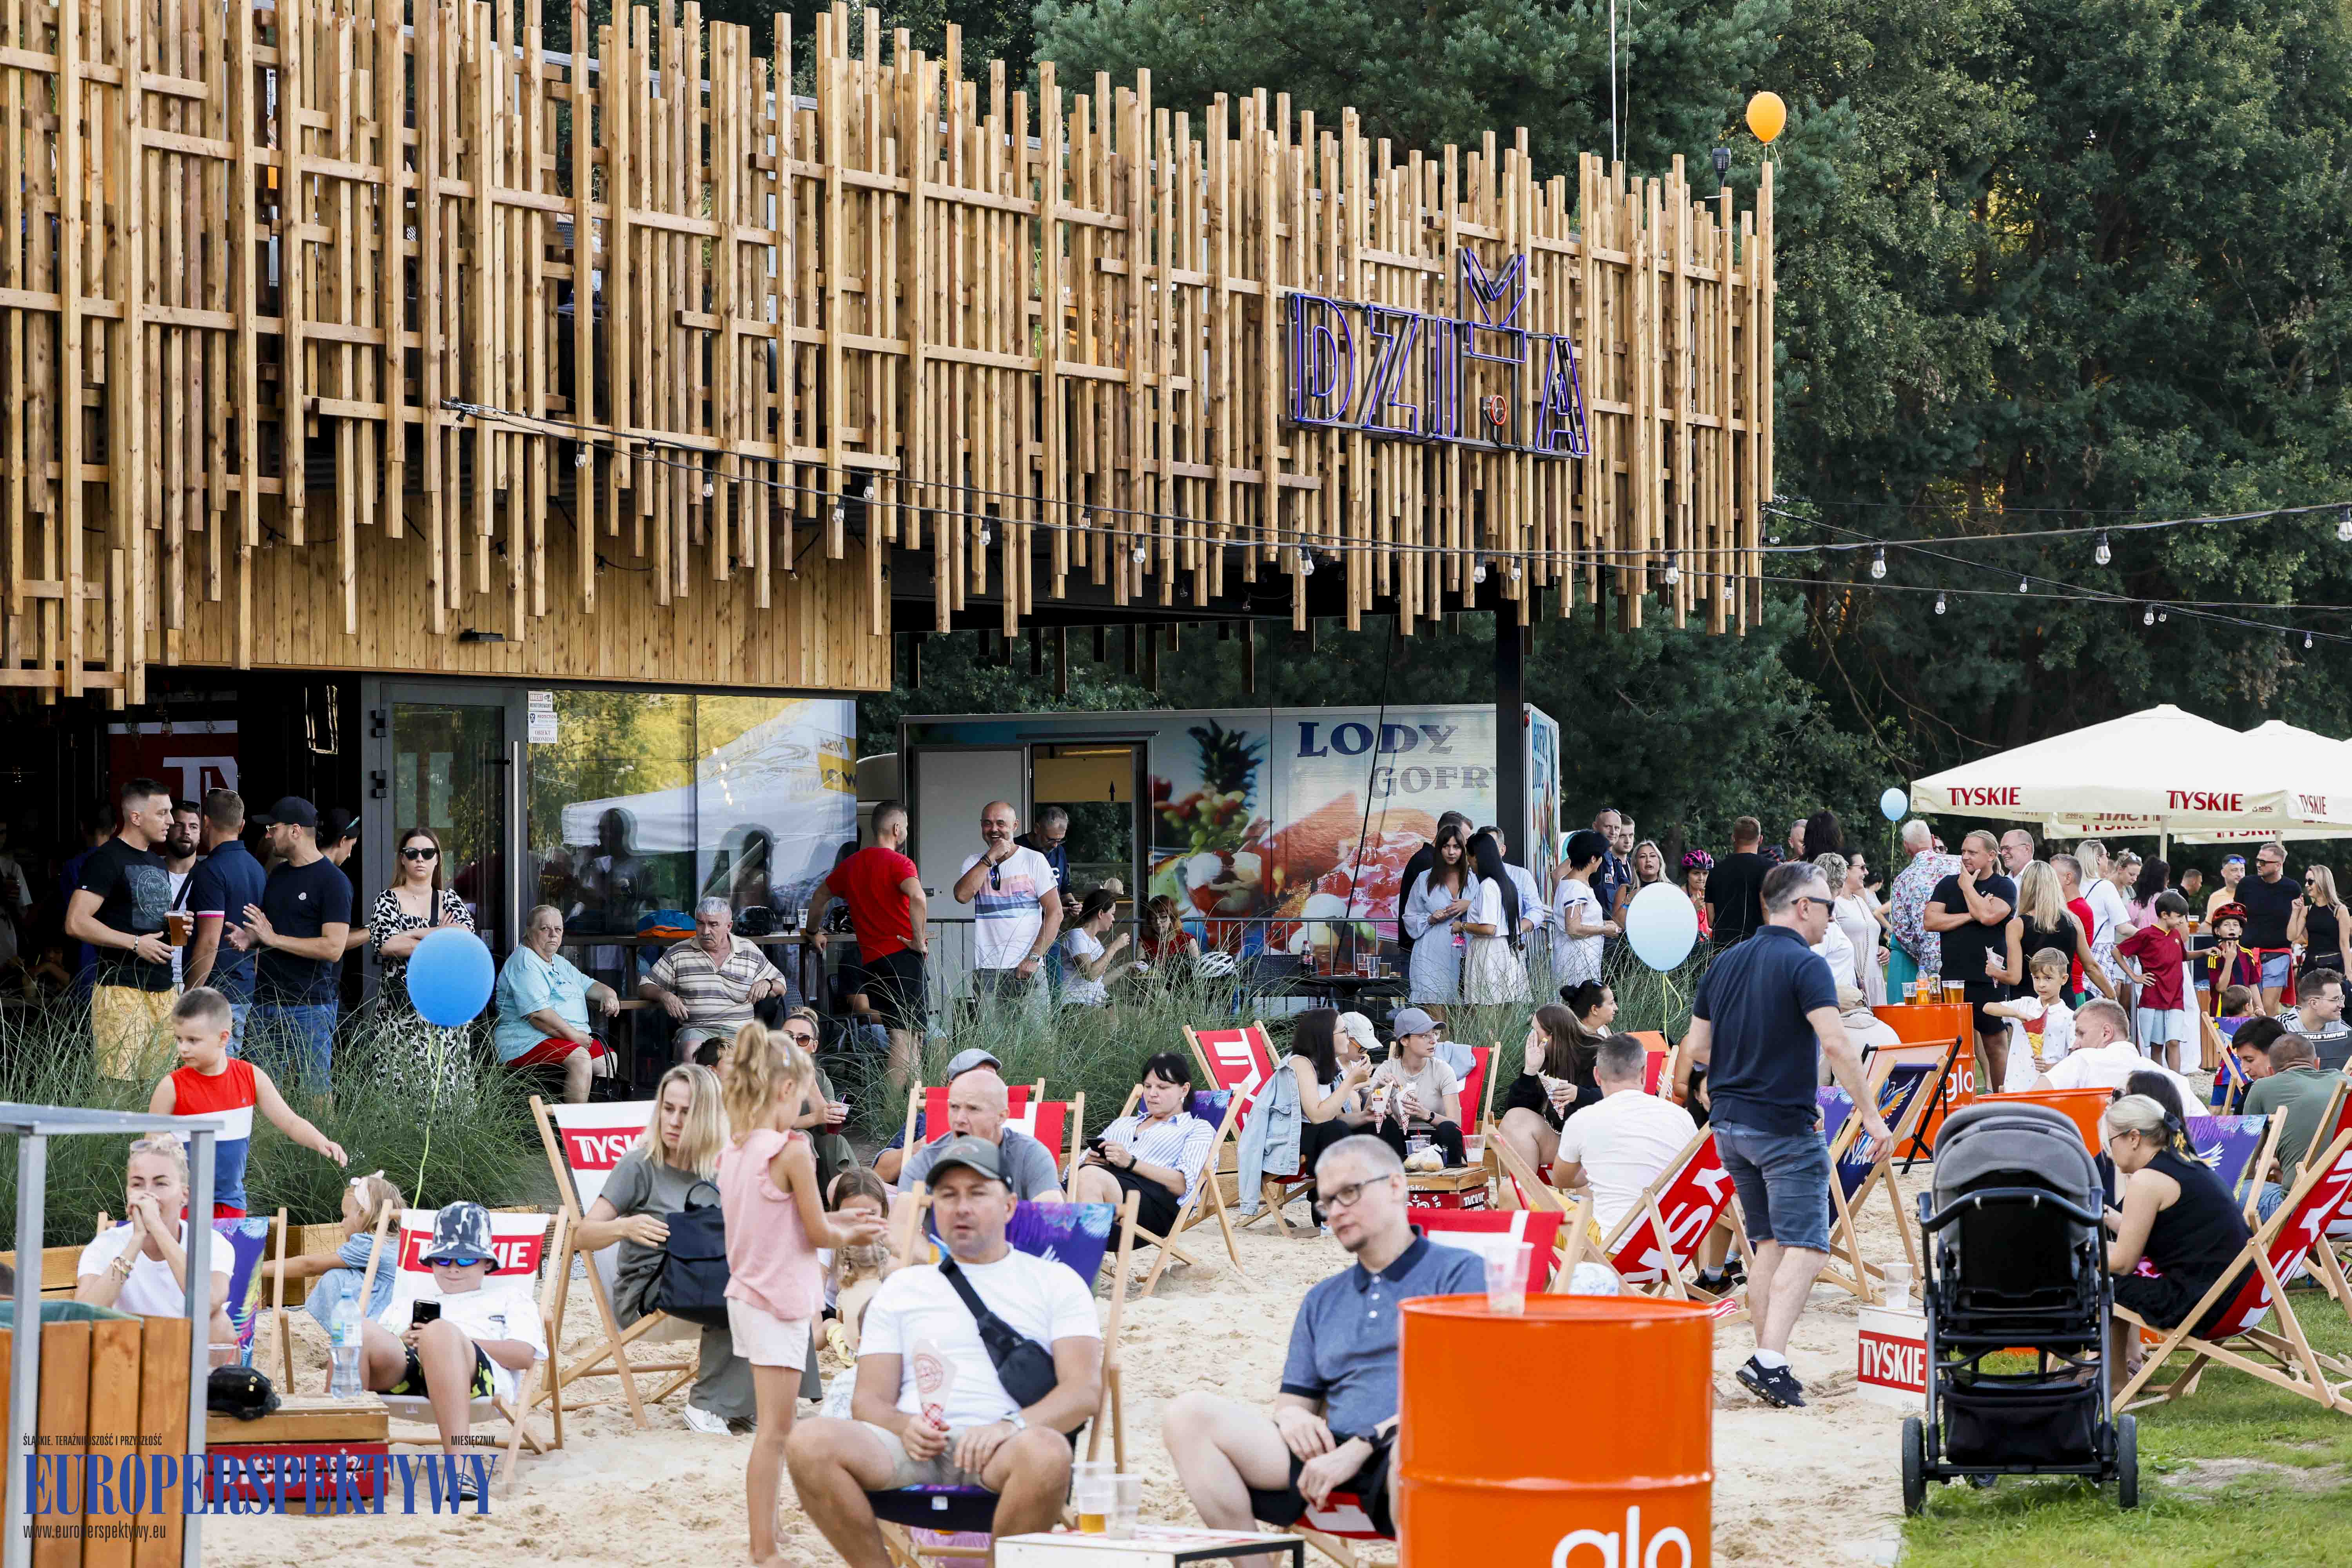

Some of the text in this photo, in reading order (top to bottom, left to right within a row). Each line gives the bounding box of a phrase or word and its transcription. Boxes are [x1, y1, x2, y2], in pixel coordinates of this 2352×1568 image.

[1297, 722, 1458, 758] LODY
[1368, 765, 1496, 799] GOFR
[1947, 787, 2021, 806] TYSKIE
[2166, 790, 2243, 811] TYSKIE
[2299, 795, 2327, 815] TYSKIE
[1938, 1064, 1975, 1102] glo
[1860, 1338, 1926, 1387] TYSKIE
